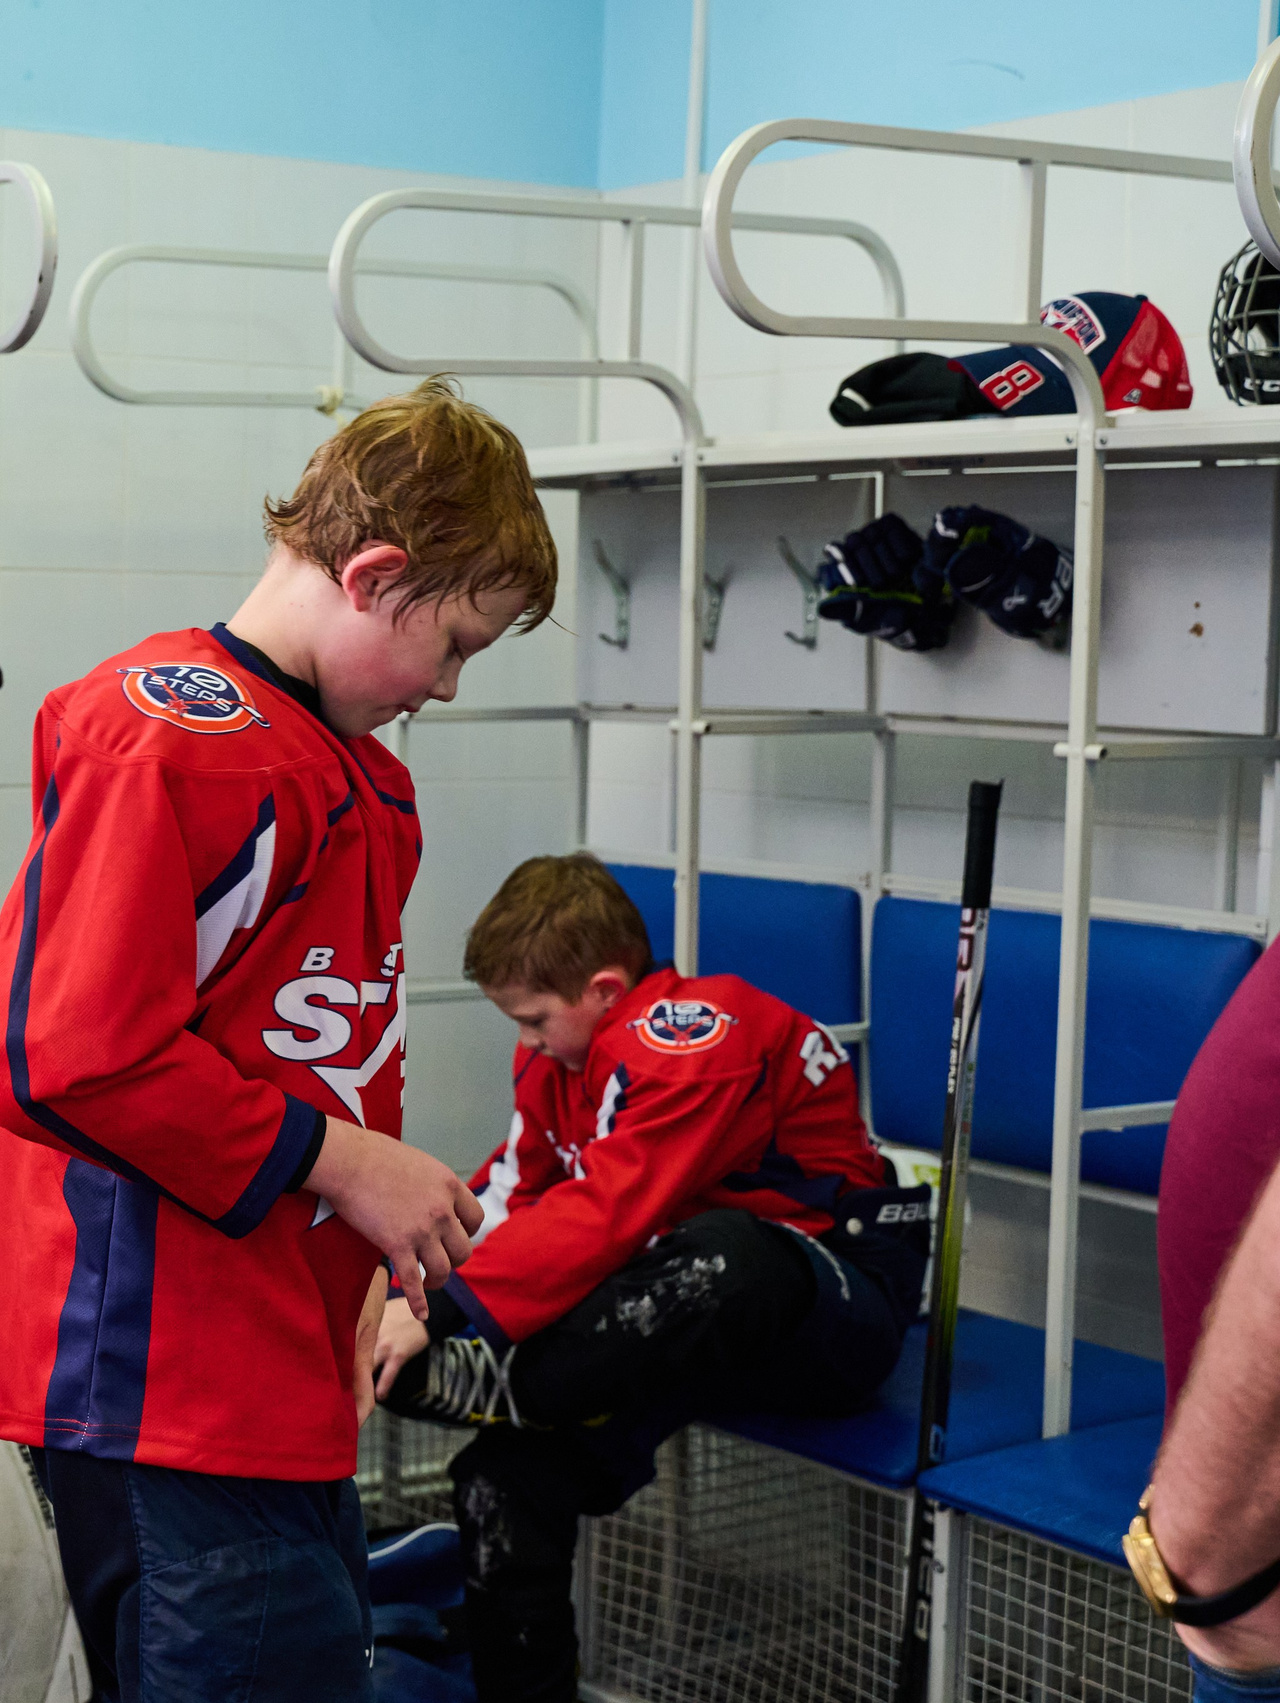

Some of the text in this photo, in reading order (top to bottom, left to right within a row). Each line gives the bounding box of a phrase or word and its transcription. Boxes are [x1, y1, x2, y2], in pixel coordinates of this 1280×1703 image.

[175, 666, 228, 692] 10
[147, 675, 233, 712] STEPS
[662, 1002, 703, 1015] 10
[652, 1014, 714, 1030] STEPS
